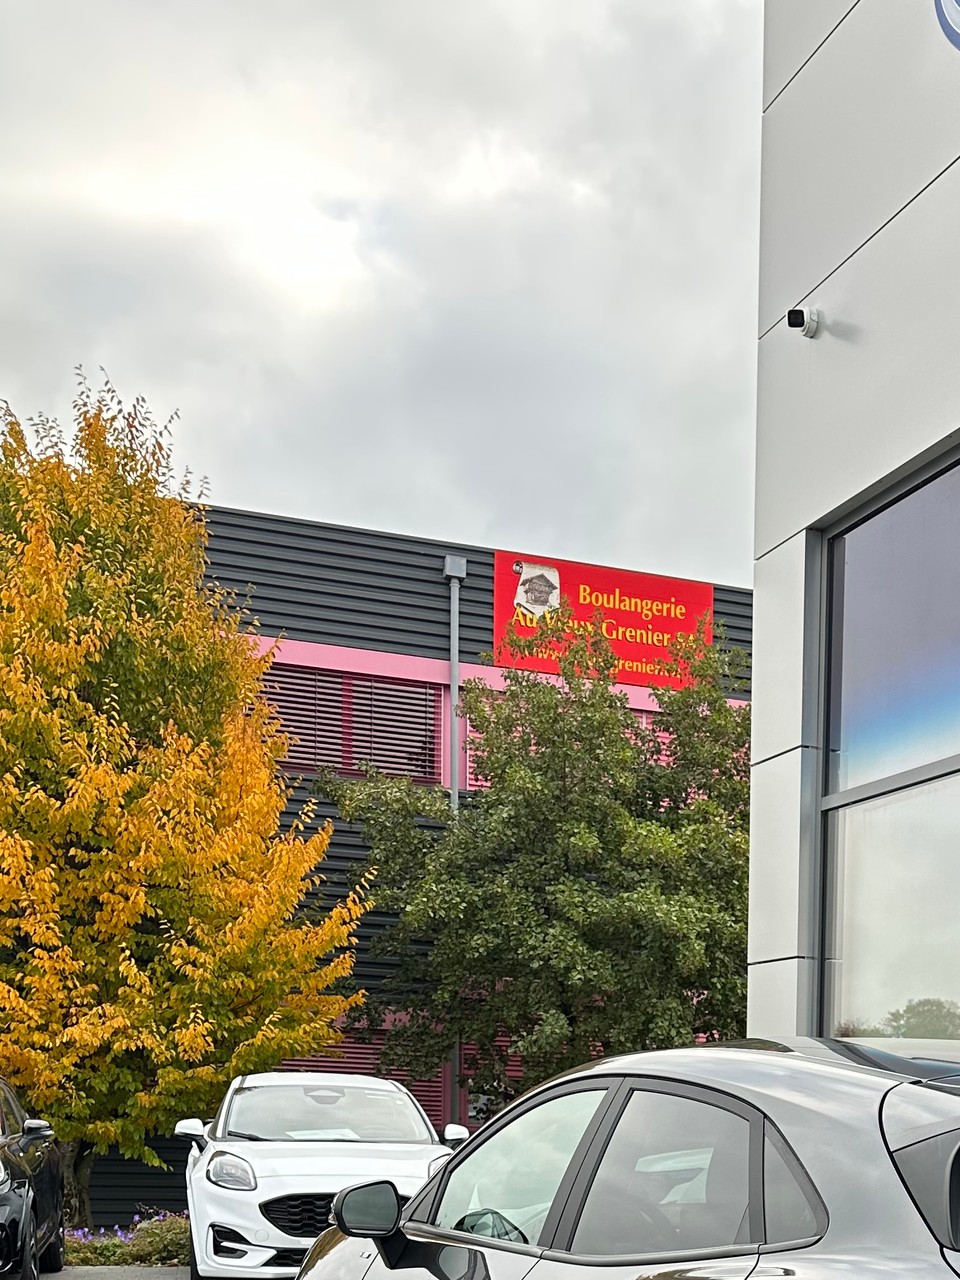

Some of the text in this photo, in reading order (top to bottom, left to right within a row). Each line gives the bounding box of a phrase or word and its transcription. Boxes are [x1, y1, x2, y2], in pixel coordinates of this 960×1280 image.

[579, 584, 686, 621] Boulangerie
[512, 606, 537, 628] Au
[601, 619, 671, 647] Grenier
